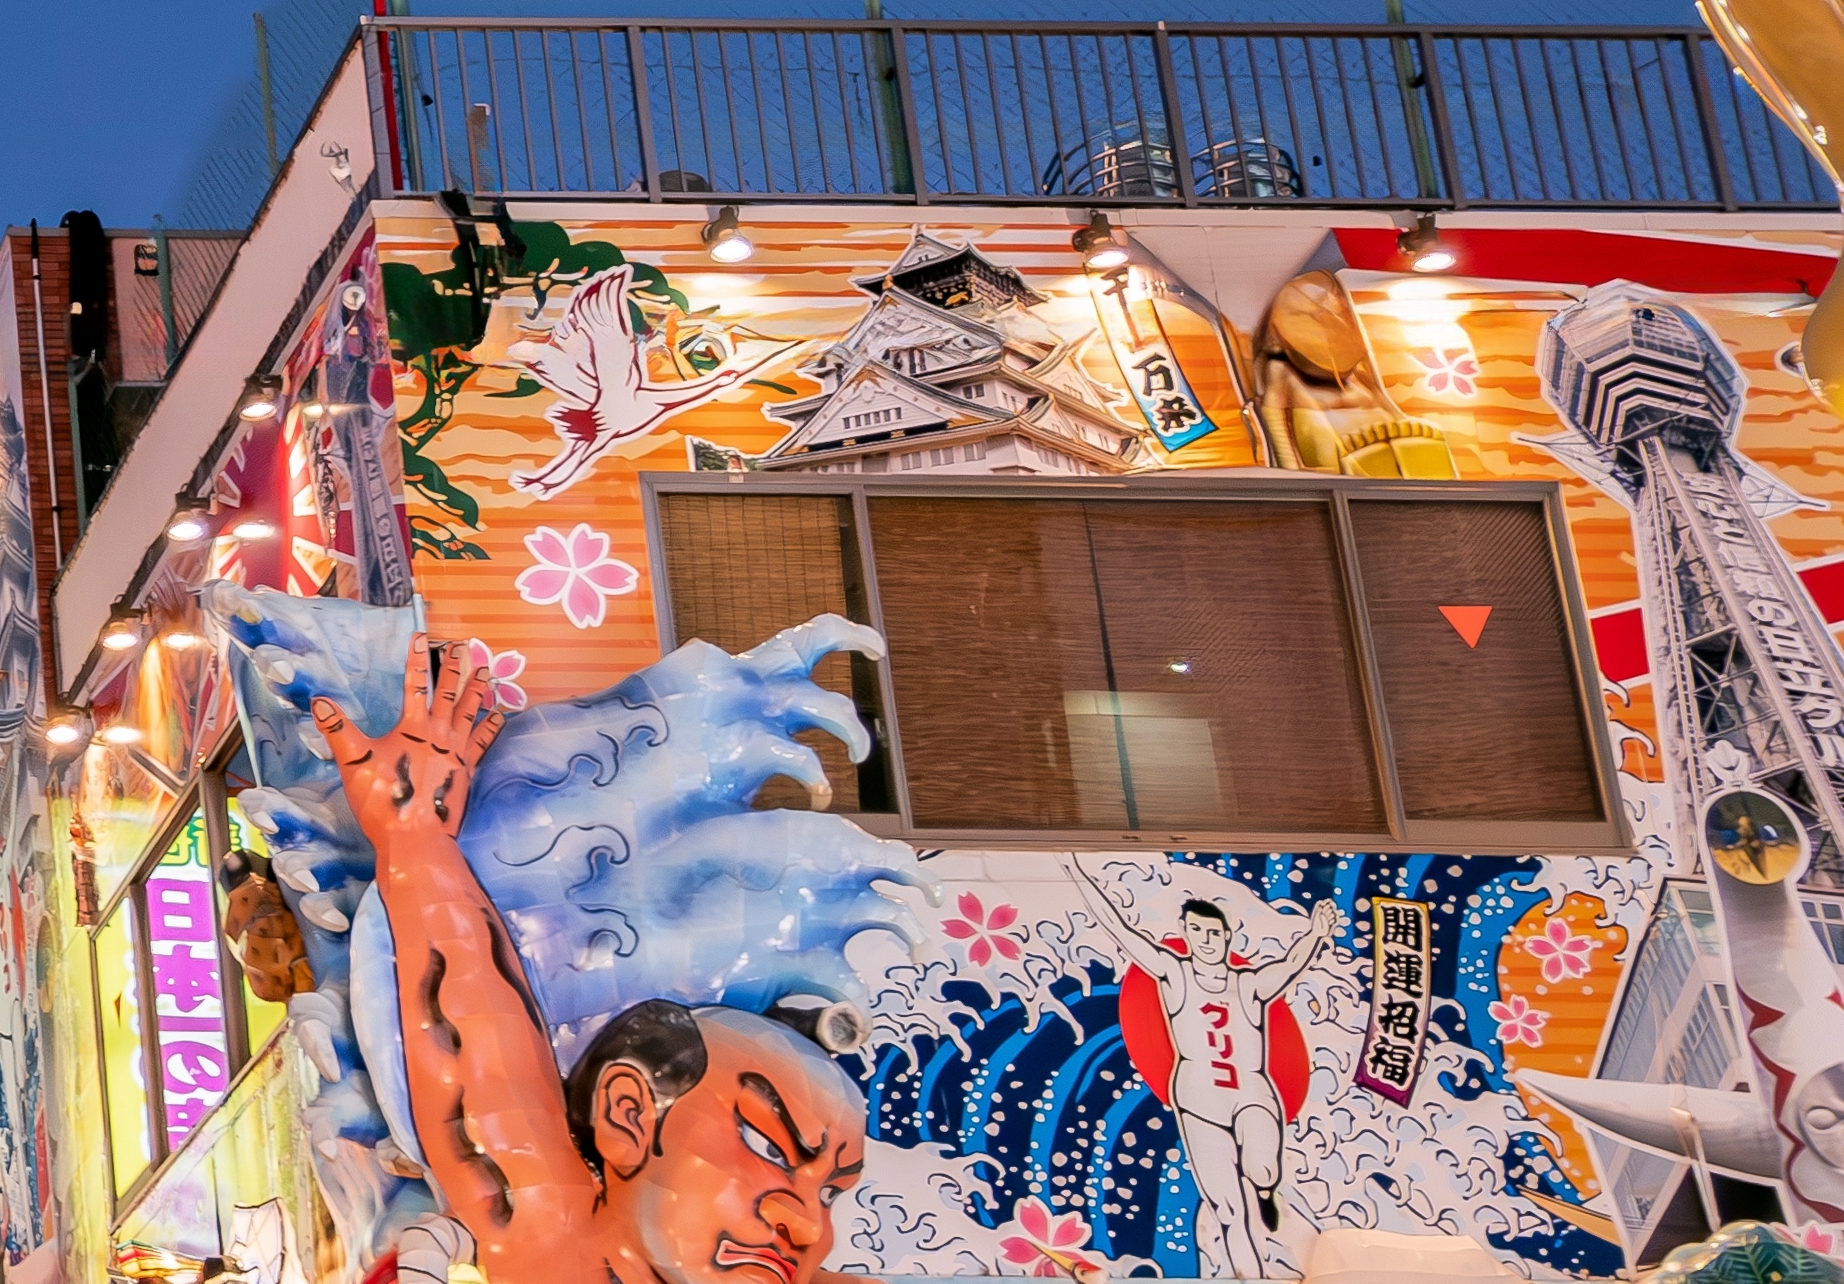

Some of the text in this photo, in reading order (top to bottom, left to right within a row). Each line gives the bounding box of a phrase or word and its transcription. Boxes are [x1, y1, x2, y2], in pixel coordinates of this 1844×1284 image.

[1197, 1001, 1243, 1091] グリコ
[1366, 900, 1429, 1090] 開運招福
